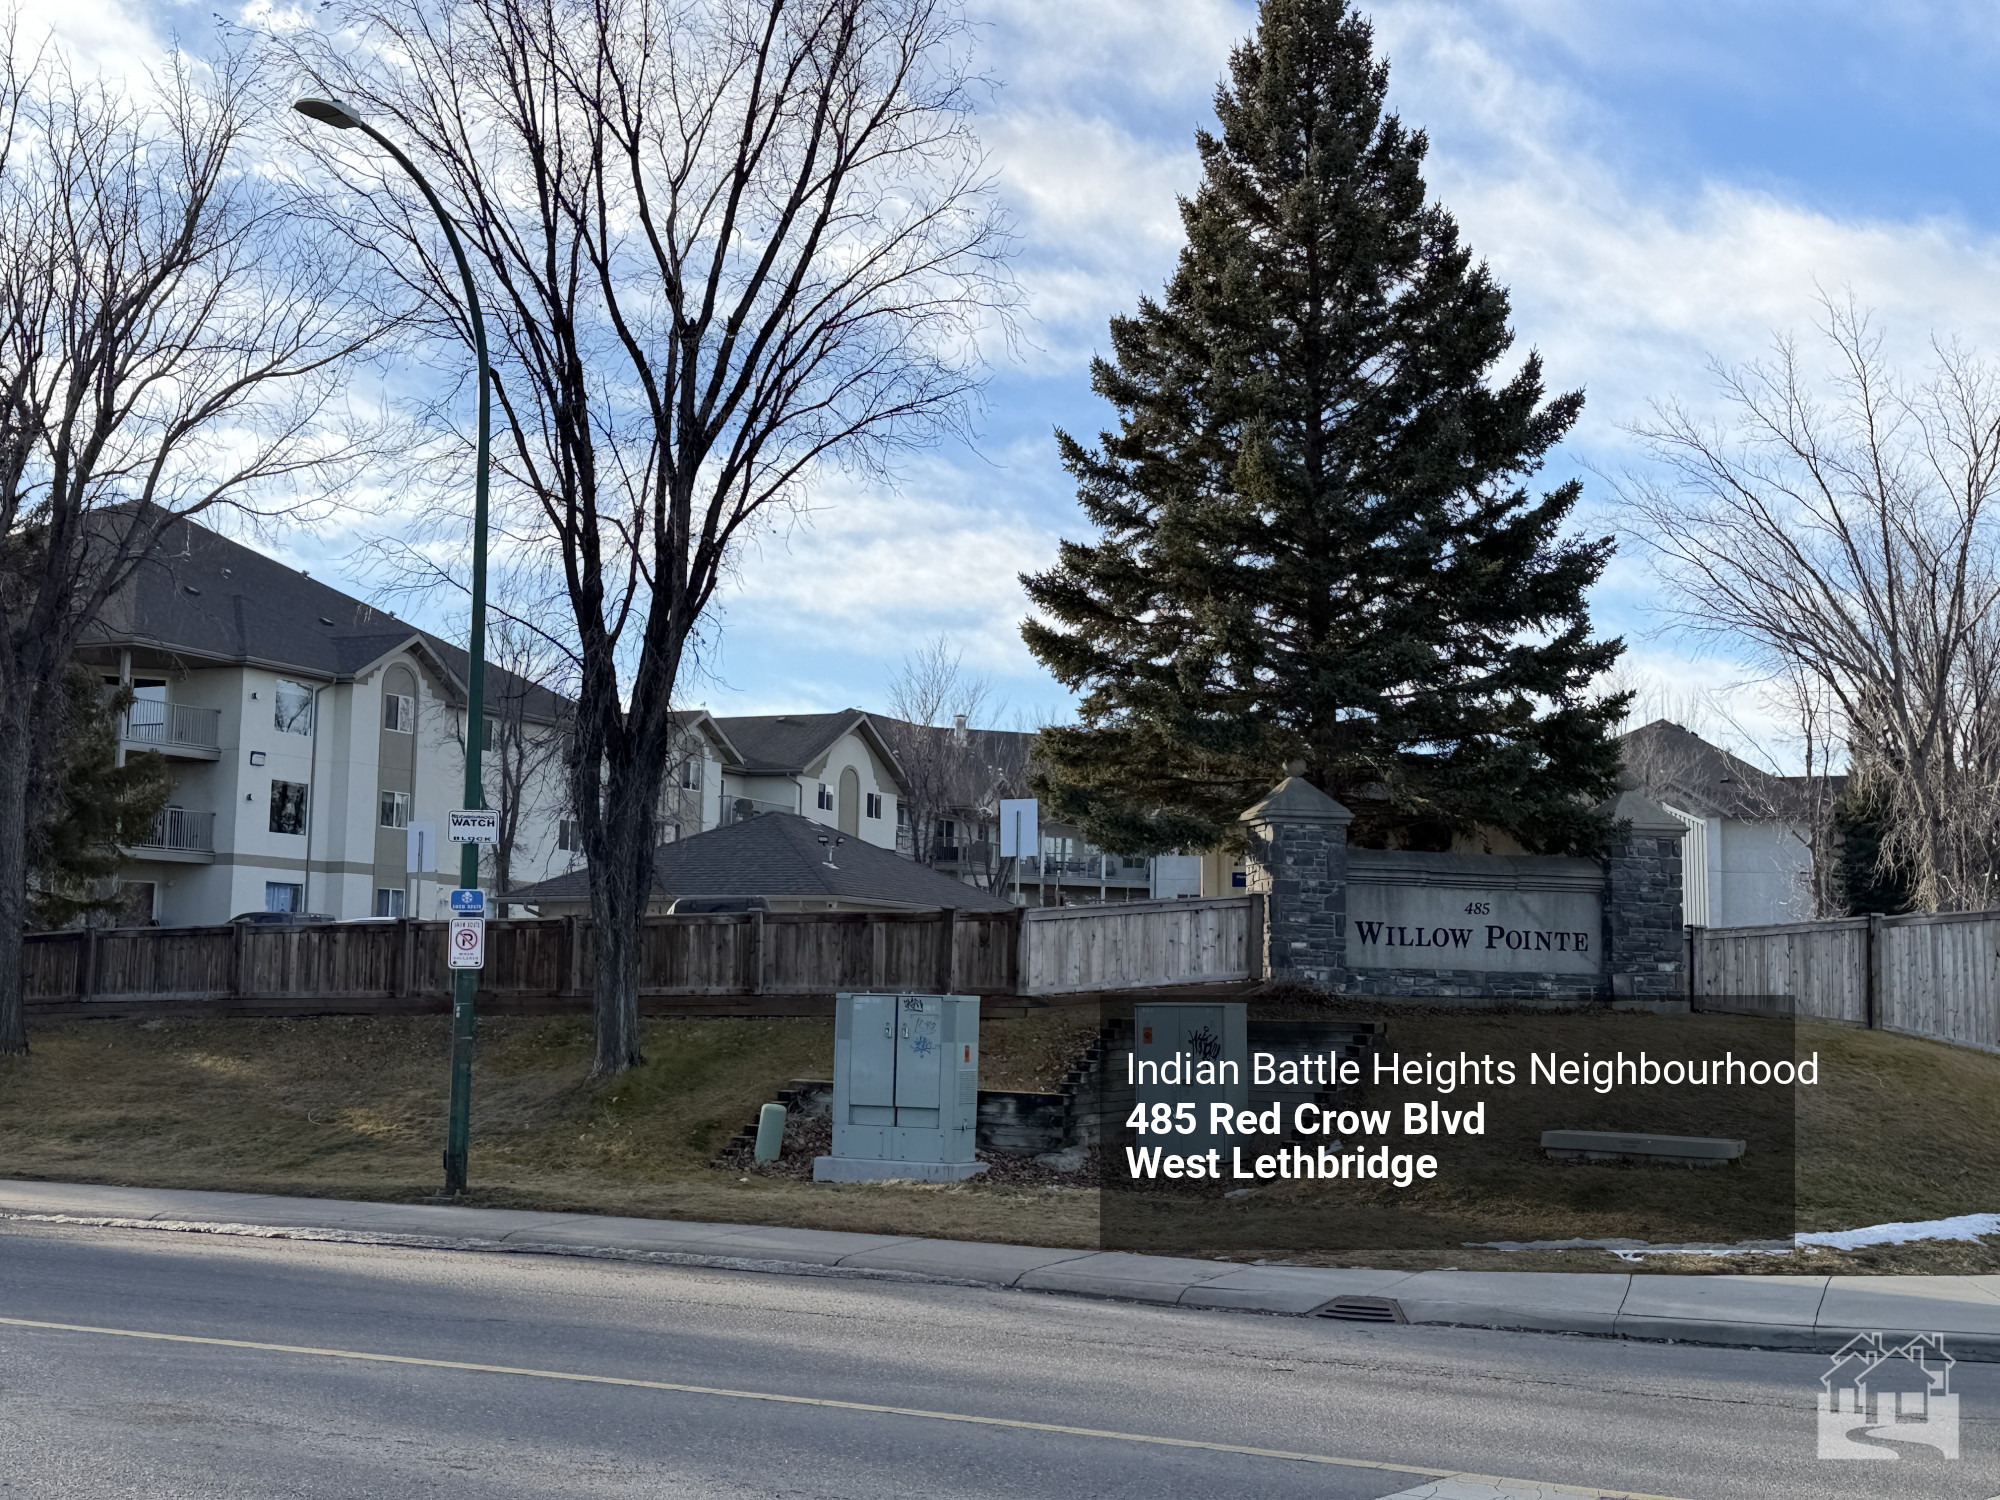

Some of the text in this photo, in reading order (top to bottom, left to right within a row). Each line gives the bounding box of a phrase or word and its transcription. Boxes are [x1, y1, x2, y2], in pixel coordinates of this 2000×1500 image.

[452, 818, 495, 827] WATCH
[1464, 902, 1490, 915] 485
[1354, 920, 1589, 952] WILLOW POINTE
